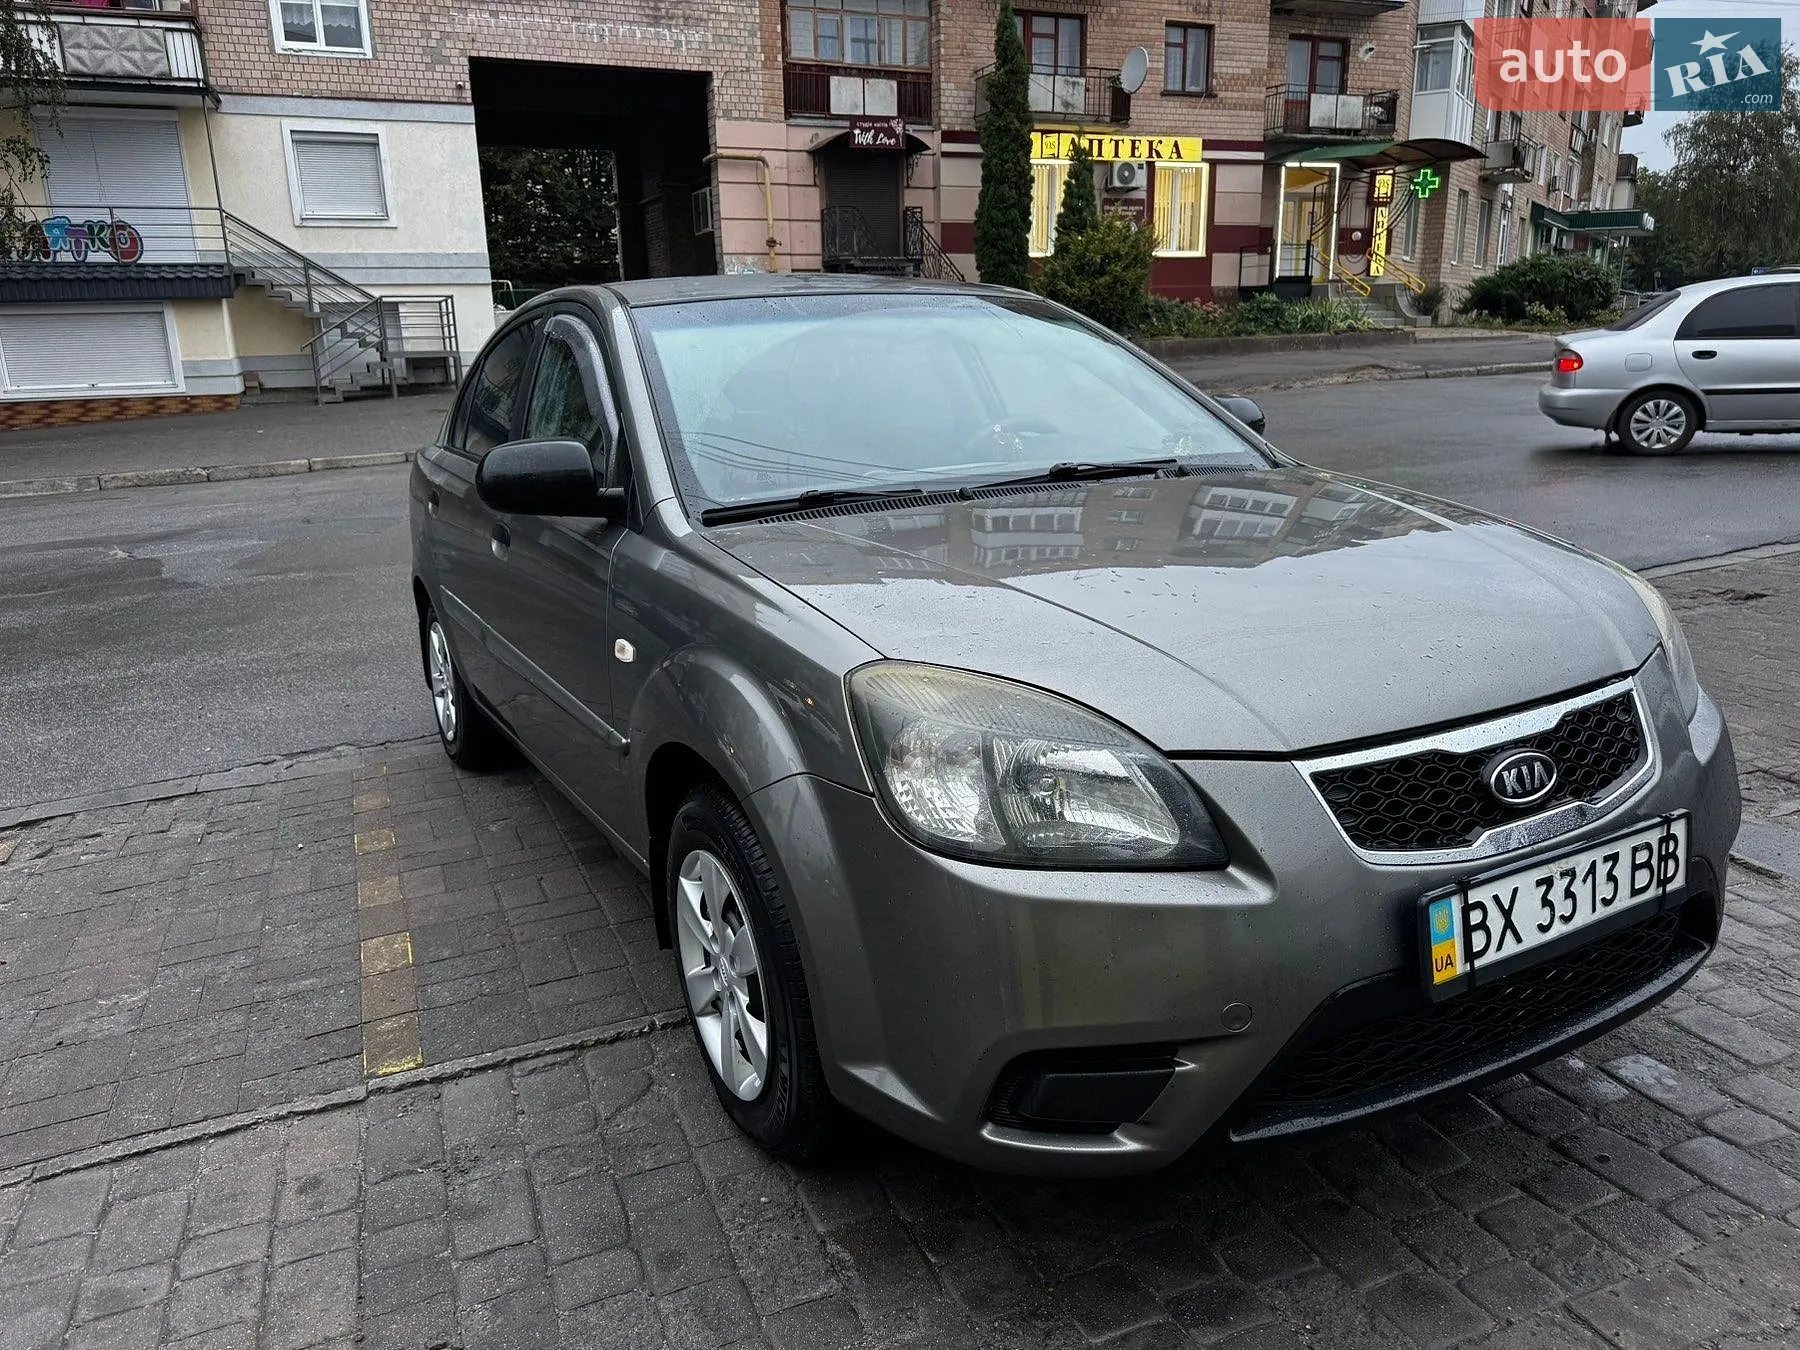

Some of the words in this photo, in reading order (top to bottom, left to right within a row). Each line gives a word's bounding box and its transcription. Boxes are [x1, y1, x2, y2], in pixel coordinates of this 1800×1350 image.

[1065, 136, 1183, 160] АПТЕКА
[1501, 761, 1550, 796] KIA
[1461, 886, 1523, 964] BX
[1535, 850, 1620, 934] 3313
[1630, 832, 1680, 899] BB
[1434, 953, 1454, 973] UA
